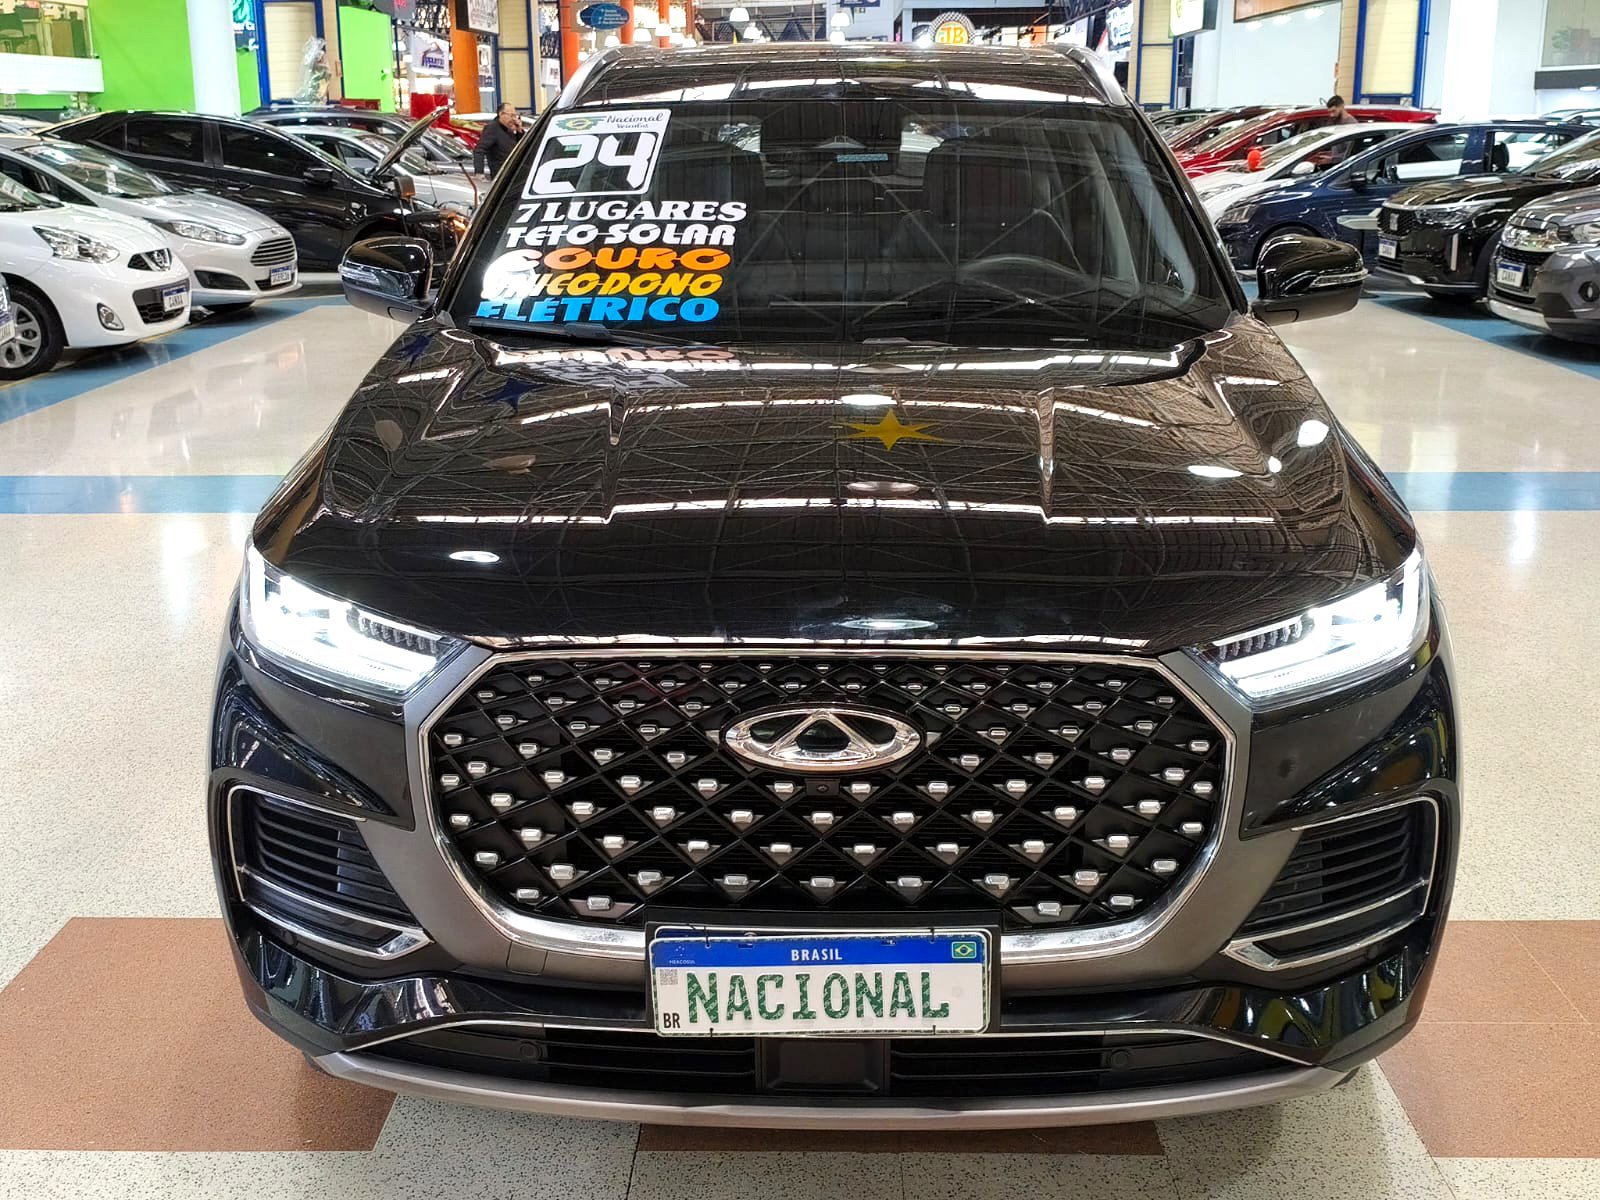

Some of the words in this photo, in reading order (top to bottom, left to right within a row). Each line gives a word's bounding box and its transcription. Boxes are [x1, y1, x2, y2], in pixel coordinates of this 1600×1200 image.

[607, 112, 663, 123] Nacional
[532, 132, 656, 194] 24
[517, 203, 541, 223] 7
[541, 201, 747, 222] LUGARES
[506, 224, 600, 248] TETO
[603, 224, 736, 246] SOLAR
[487, 247, 731, 271] COURO
[599, 272, 723, 297] DONO
[475, 296, 719, 322] ELÉTRICO
[790, 948, 843, 961] BRASIL
[686, 971, 950, 1023] NACIONAL
[663, 1012, 681, 1029] BR
